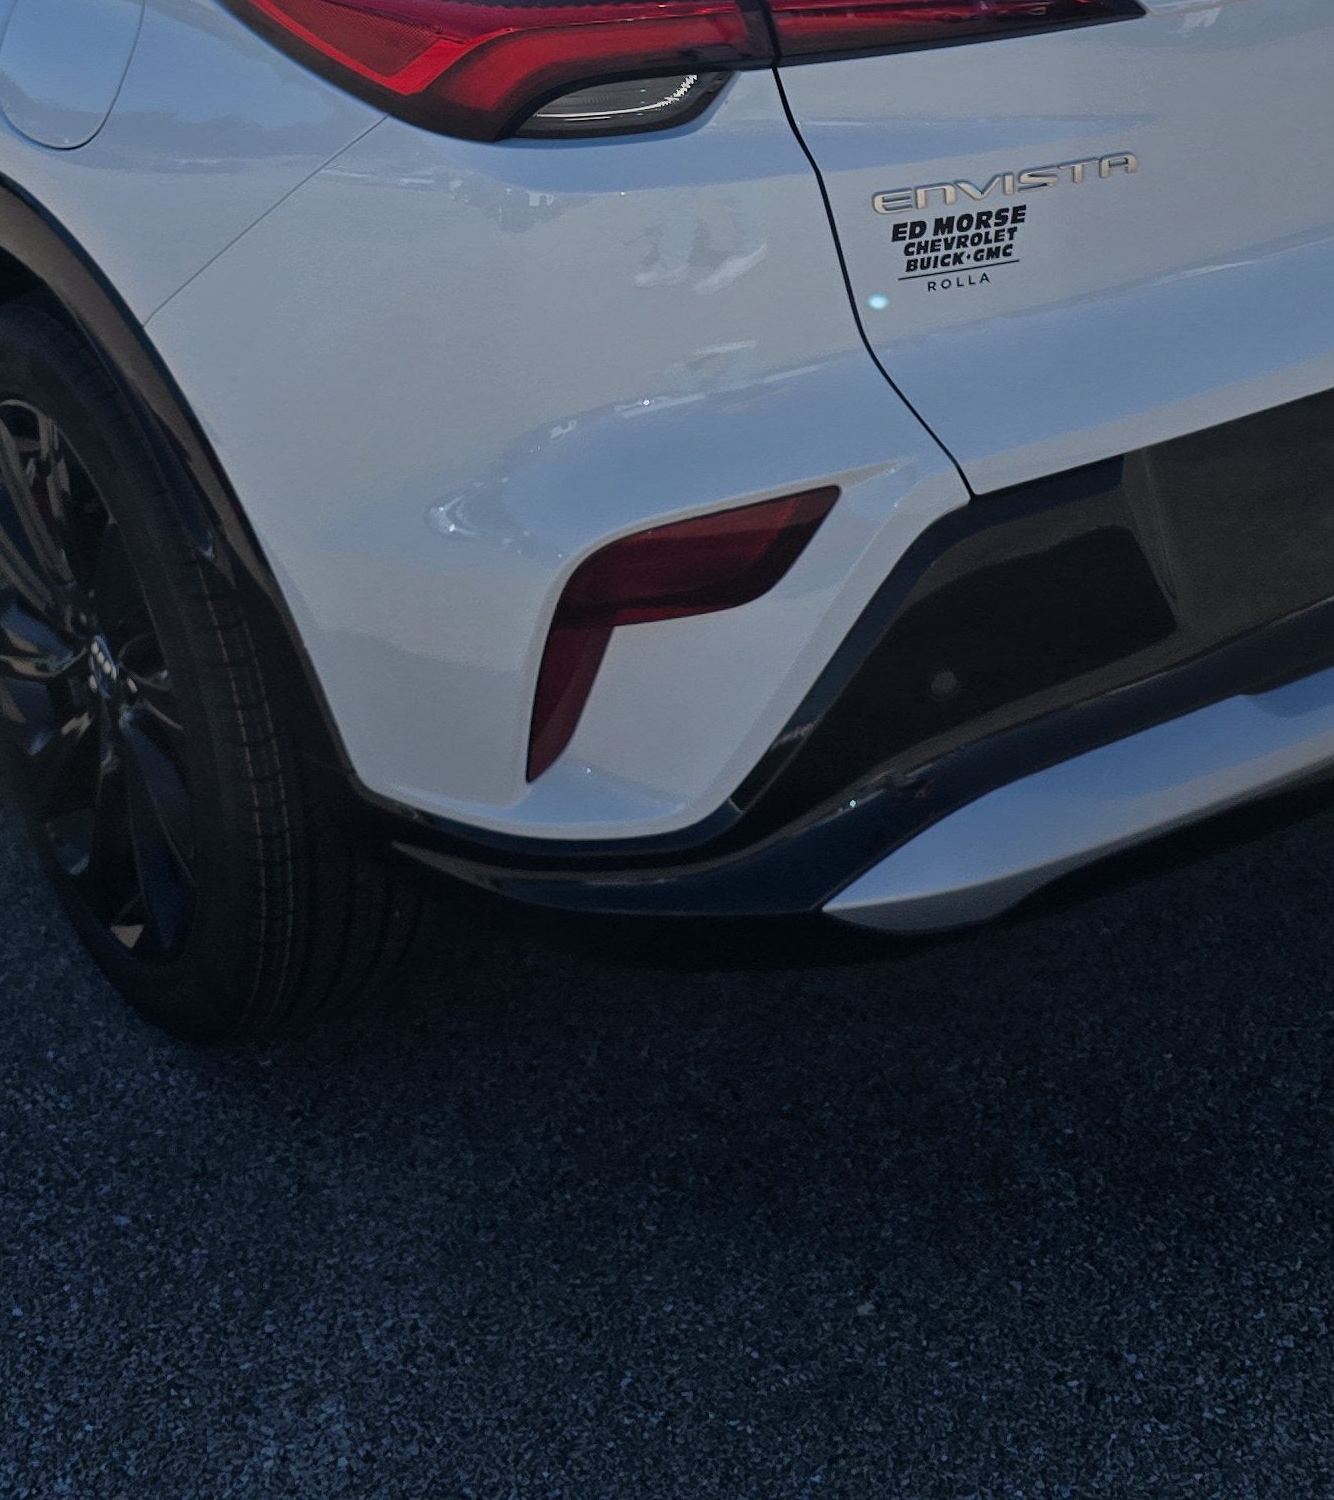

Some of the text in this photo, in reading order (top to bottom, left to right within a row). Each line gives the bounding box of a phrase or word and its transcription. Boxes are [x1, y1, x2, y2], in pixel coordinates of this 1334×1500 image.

[872, 152, 1140, 215] ENVISTA
[891, 204, 1027, 242] ED MORSE
[903, 226, 1019, 257] CHEVROLET
[927, 272, 991, 292] ROLLA
